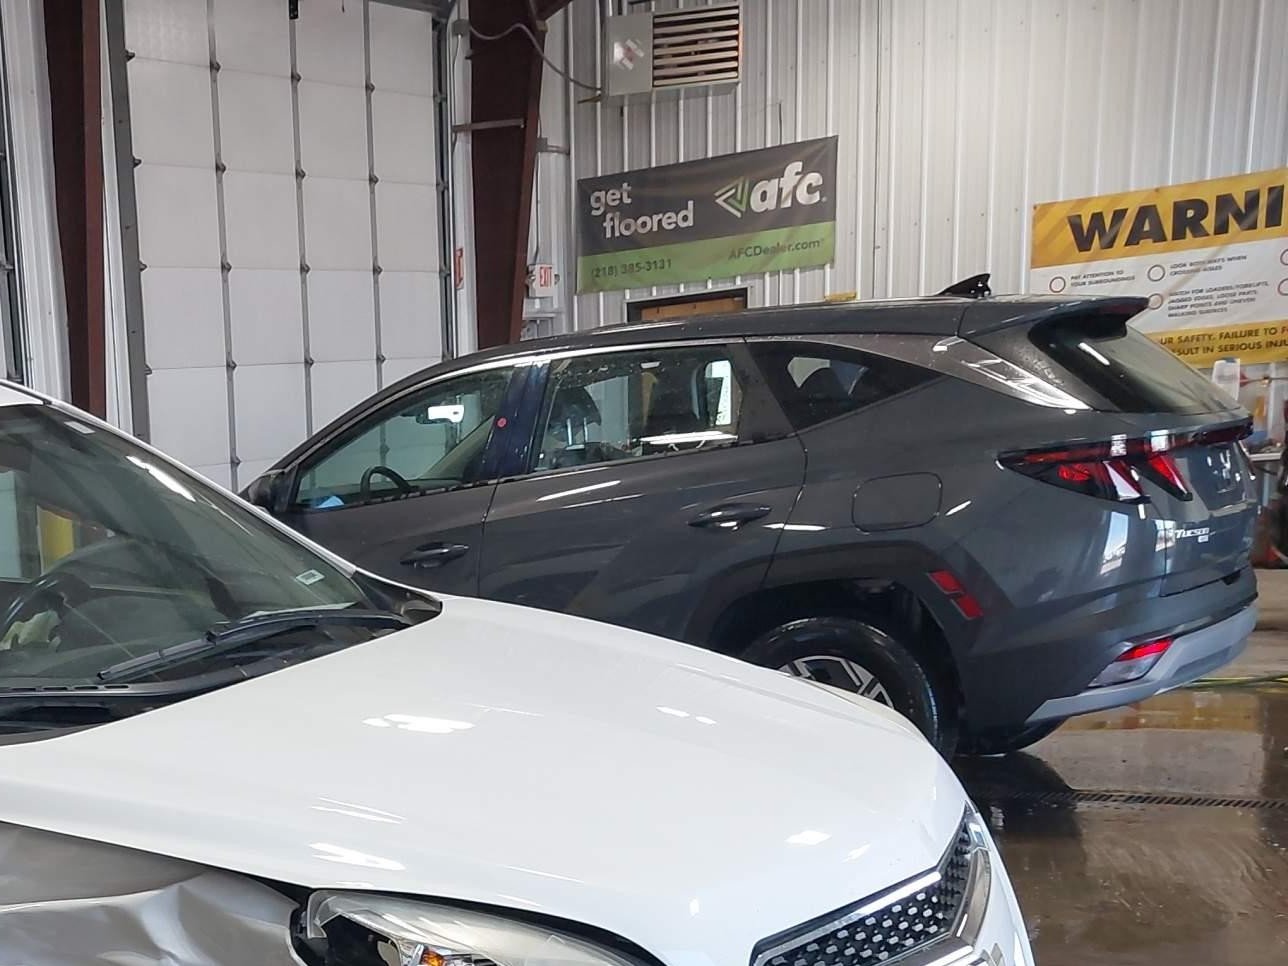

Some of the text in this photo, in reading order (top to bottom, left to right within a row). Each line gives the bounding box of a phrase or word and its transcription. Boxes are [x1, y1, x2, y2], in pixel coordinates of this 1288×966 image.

[590, 182, 632, 216] get
[750, 161, 823, 214] afc
[603, 200, 695, 239] floored
[1067, 184, 1285, 253] WARNI
[728, 239, 822, 261] AFCDealer.com
[591, 266, 619, 279] (218)
[1202, 346, 1214, 354] IN
[1218, 342, 1263, 353] SERIOUS
[1219, 329, 1260, 341] FAILURE
[1264, 327, 1278, 336] TO
